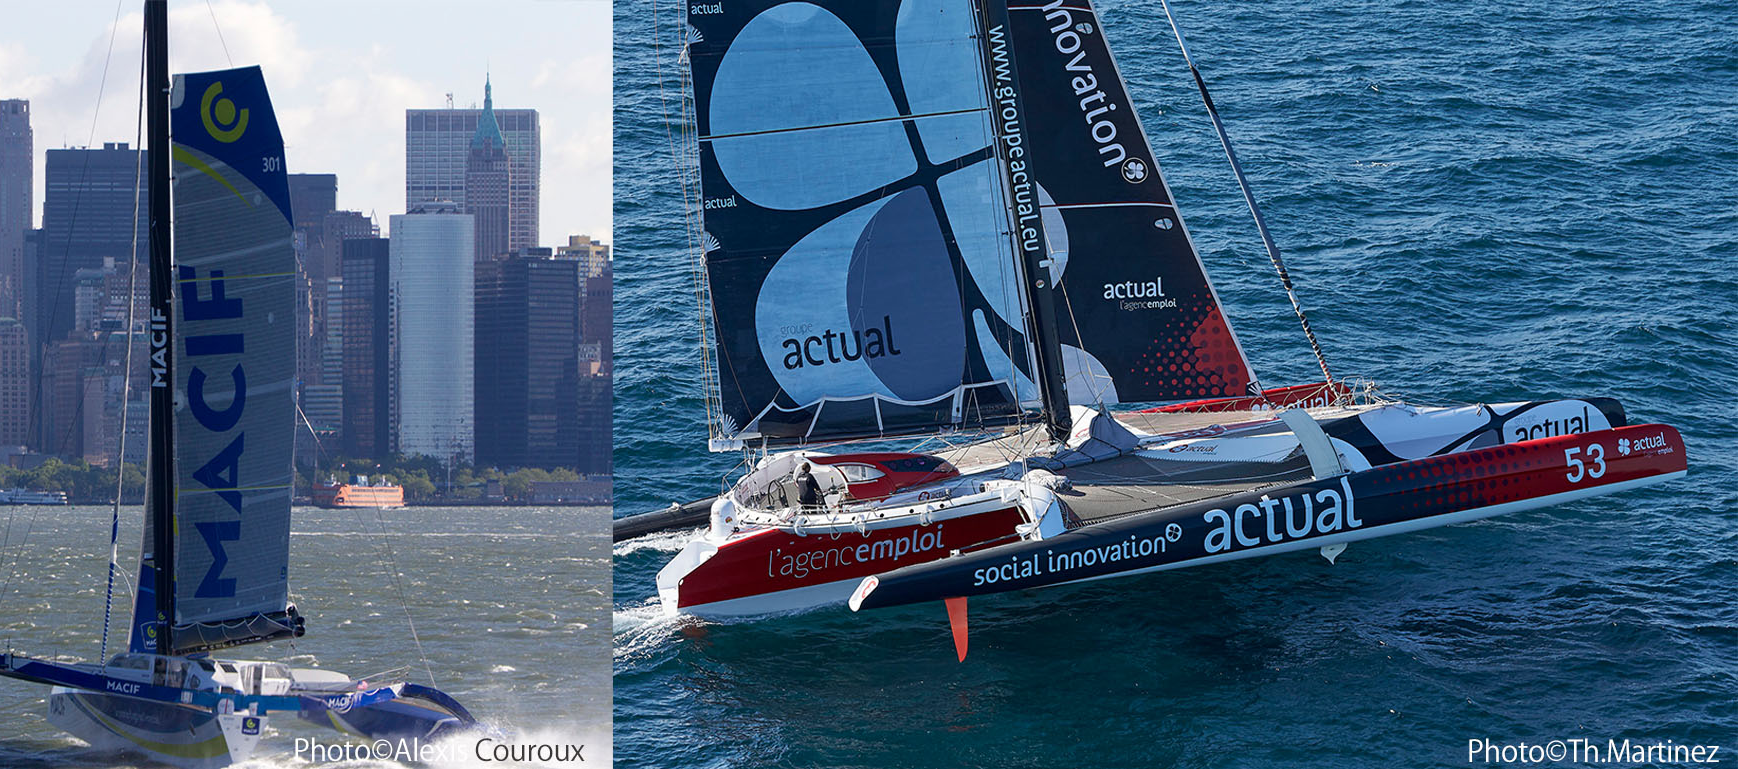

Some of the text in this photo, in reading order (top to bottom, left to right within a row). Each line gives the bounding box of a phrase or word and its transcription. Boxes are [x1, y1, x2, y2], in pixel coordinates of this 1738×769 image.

[691, 1, 724, 15] actual
[988, 24, 1040, 252] www.groupeactual.eu
[262, 156, 281, 173] 301
[704, 195, 737, 209] actual
[1103, 276, 1165, 299] actual
[150, 307, 167, 389] MACIF
[780, 322, 813, 338] groupe
[782, 315, 901, 370] actual
[178, 264, 247, 599] MACIF
[1633, 431, 1666, 451] actual
[1564, 443, 1607, 484] 53
[1203, 475, 1363, 554] actual
[768, 523, 945, 579] l'agencemploi
[974, 534, 1167, 586] social innovation
[106, 680, 141, 694] MACIF
